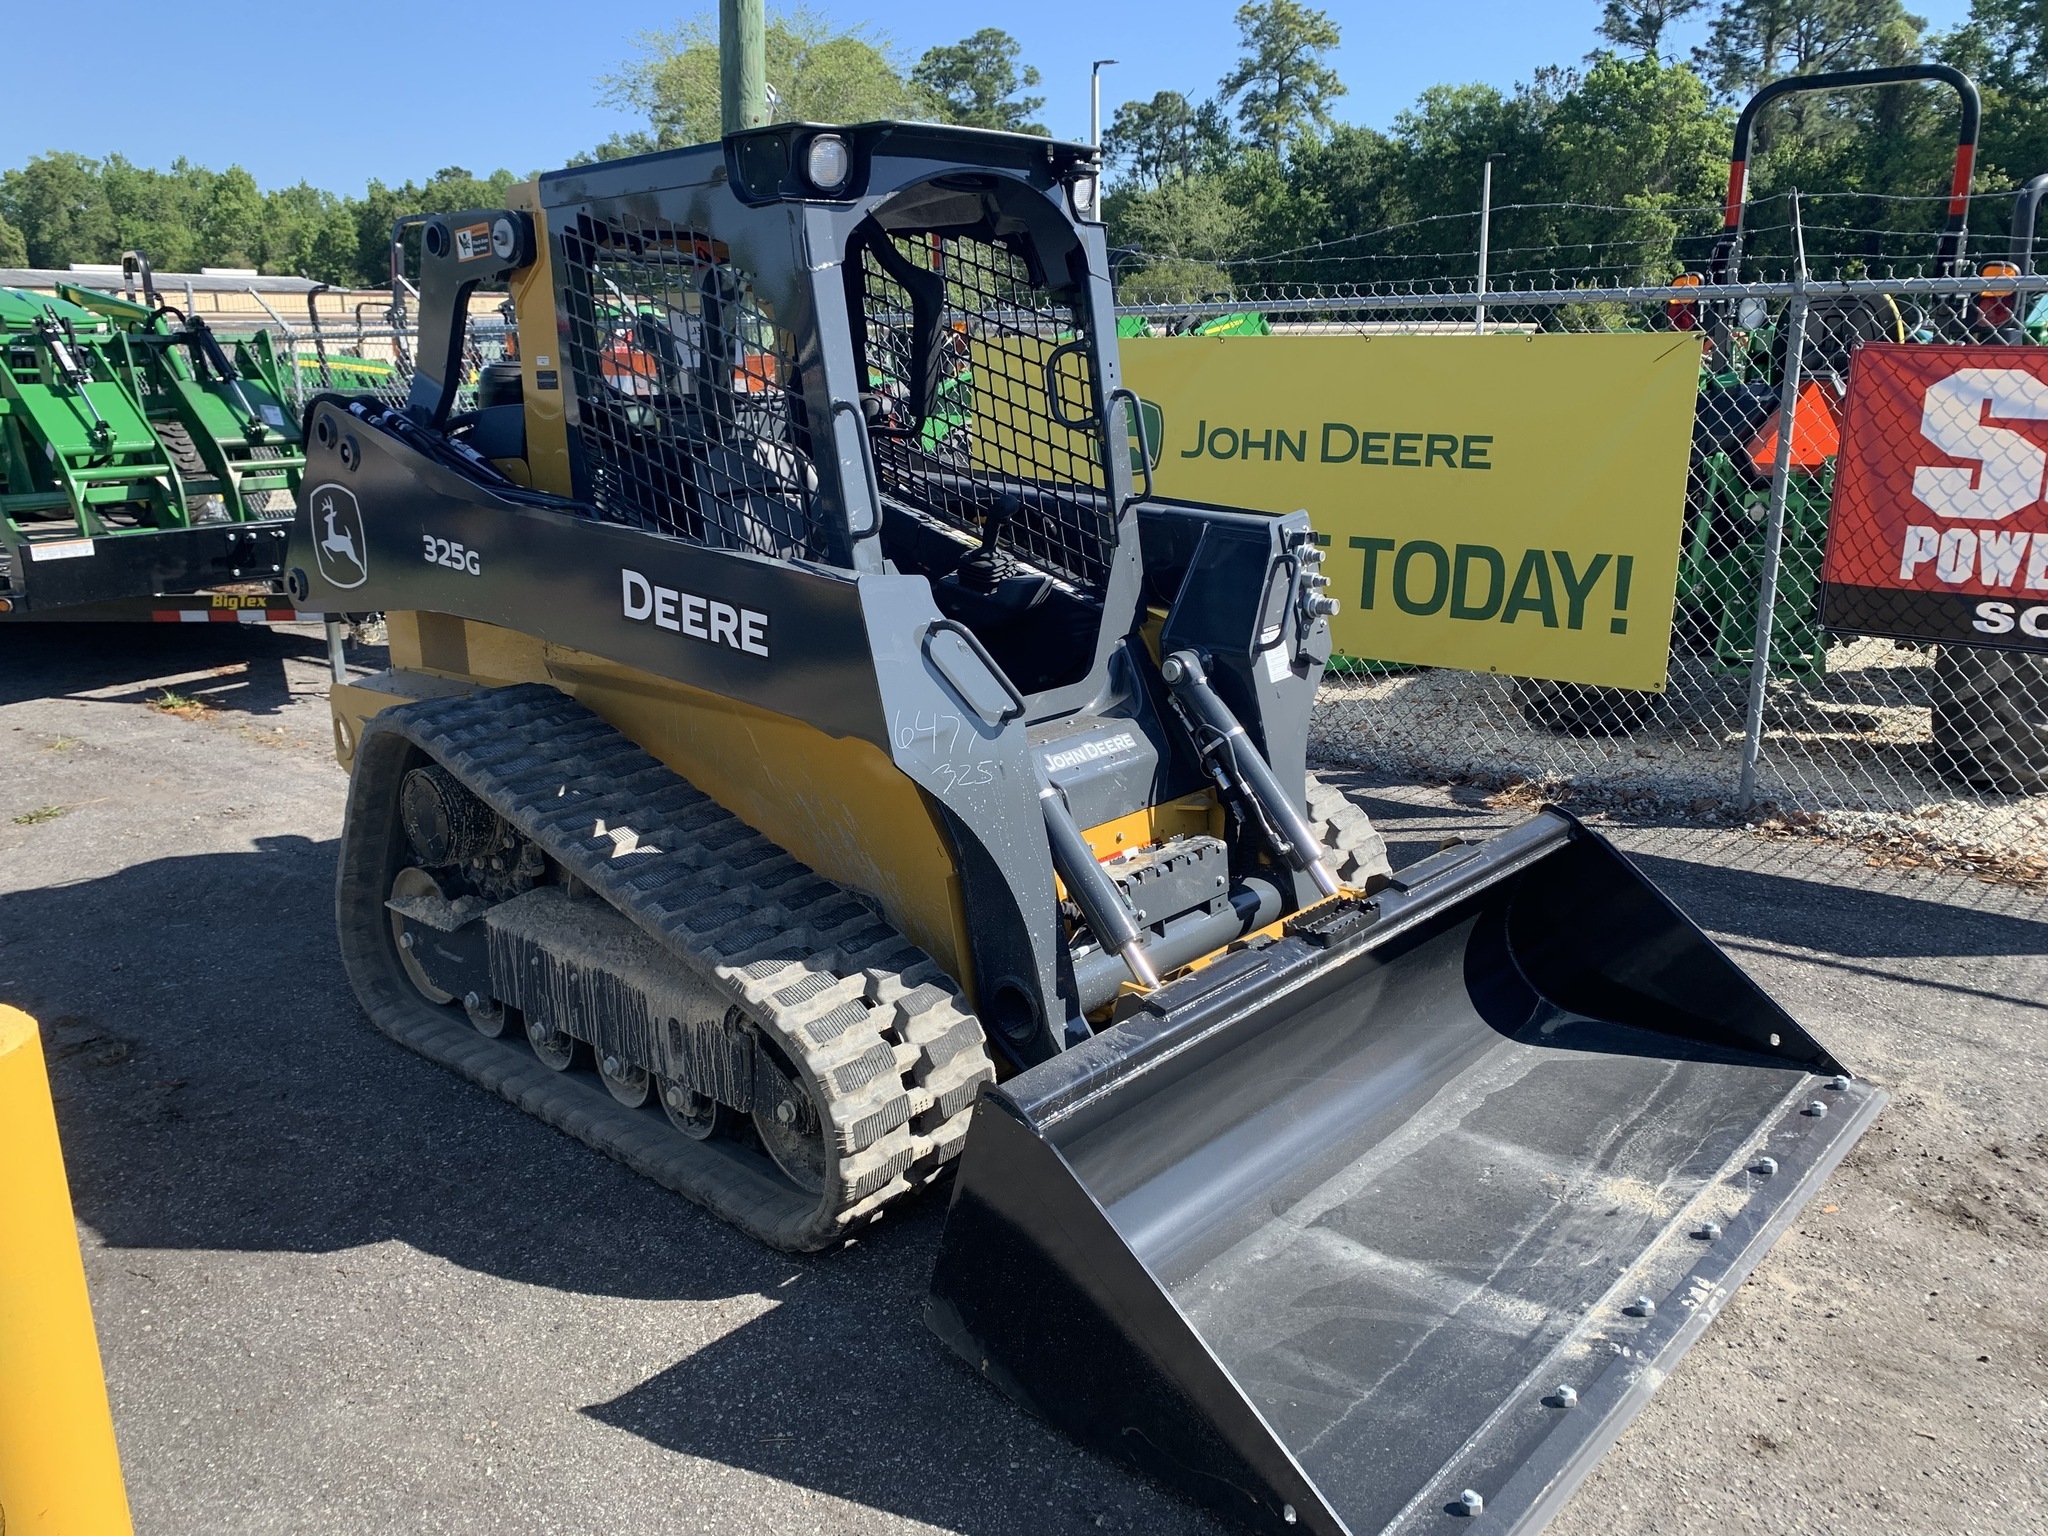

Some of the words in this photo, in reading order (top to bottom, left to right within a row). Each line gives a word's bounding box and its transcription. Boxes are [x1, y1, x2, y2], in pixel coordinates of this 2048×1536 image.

[1180, 419, 1307, 463] JOHN
[1320, 422, 1494, 470] DEERE
[422, 534, 481, 576] 325G
[1348, 535, 1635, 635] TODAY!
[621, 568, 769, 658] DEERE
[1043, 747, 1087, 773] JOHN
[1082, 732, 1138, 759] DEERE
[931, 760, 994, 795] 325
